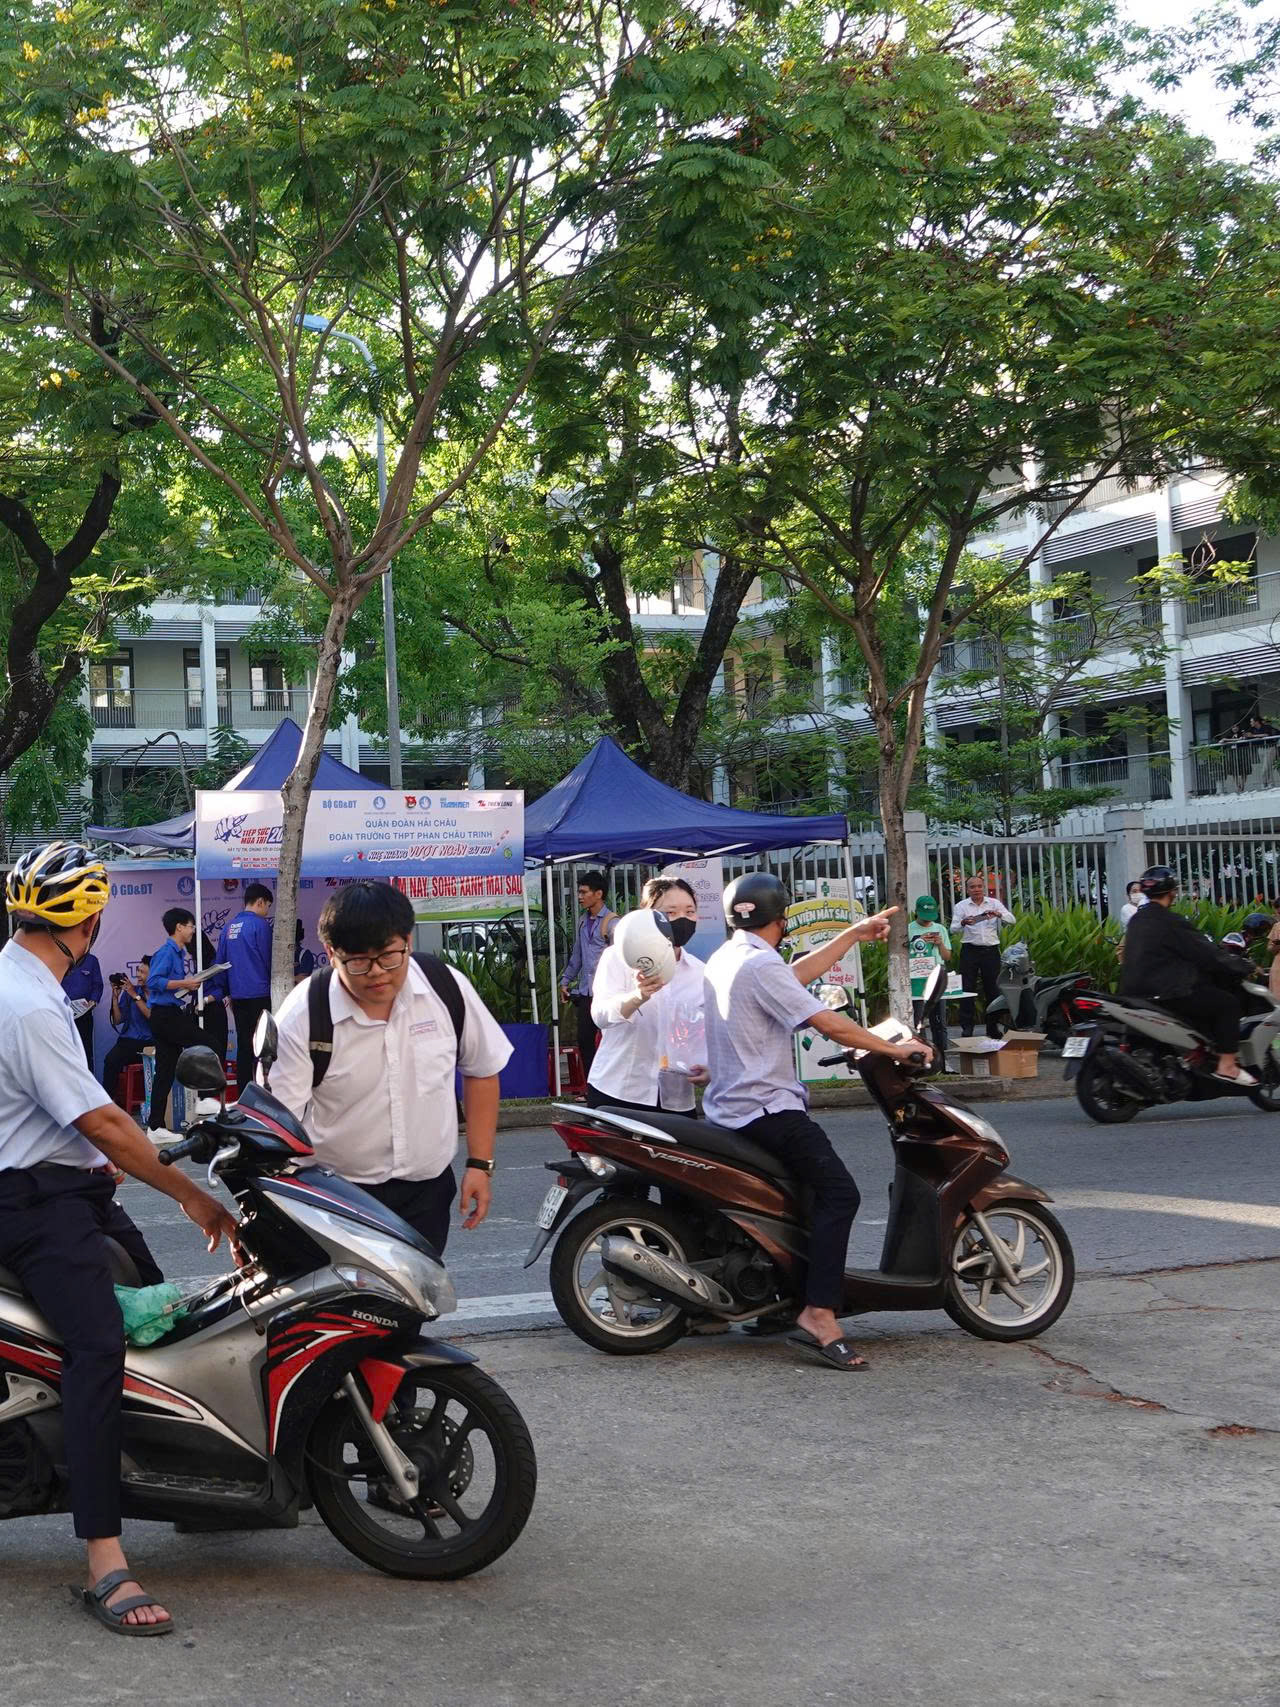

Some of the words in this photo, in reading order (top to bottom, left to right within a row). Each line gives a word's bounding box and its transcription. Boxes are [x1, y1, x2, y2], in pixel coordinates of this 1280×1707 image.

[393, 832, 415, 840] THPT
[468, 831, 493, 839] TRINH
[460, 876, 484, 896] XANH
[640, 1145, 717, 1171] VISION
[351, 1309, 400, 1328] HONDA
